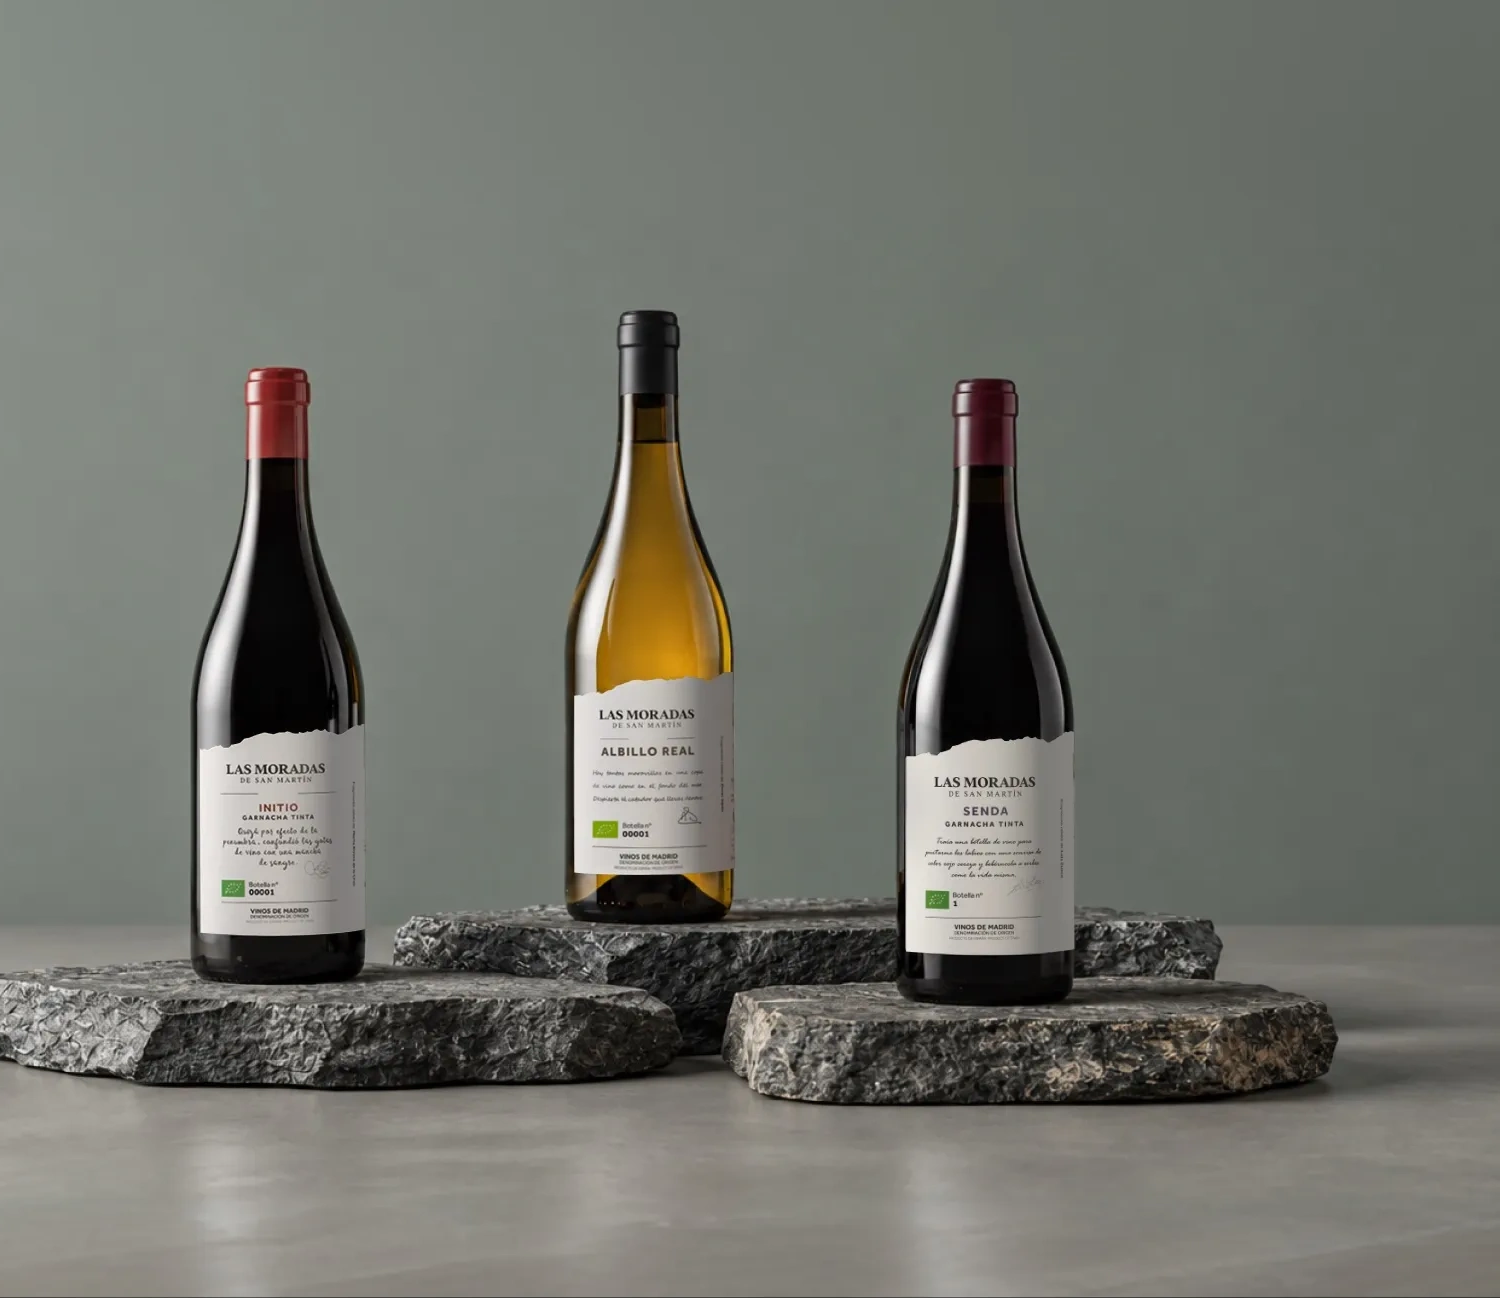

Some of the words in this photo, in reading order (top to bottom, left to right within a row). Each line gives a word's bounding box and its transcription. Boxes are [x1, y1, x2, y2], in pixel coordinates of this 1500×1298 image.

[599, 709, 623, 720] LAS
[626, 709, 695, 720] MORADAS
[601, 746, 658, 756] ALBILLO
[662, 746, 695, 756] REAL
[226, 764, 252, 775] LAS
[254, 763, 326, 775] MORADAS
[276, 776, 312, 784] MARTÍN
[934, 776, 961, 788] LAS
[963, 776, 1036, 788] MORADAS
[986, 789, 1022, 798] MARTÍN
[258, 803, 298, 812] INITIO
[963, 806, 1009, 816] SENDA
[237, 827, 258, 839] Quizá
[260, 828, 274, 838] por
[276, 828, 298, 839] efecto
[300, 826, 308, 834] de
[310, 826, 318, 834] la
[301, 837, 312, 846] las
[314, 836, 333, 848] gotas
[234, 847, 242, 856] de
[295, 848, 322, 856] mancha
[258, 858, 268, 866] de
[978, 862, 984, 870] y
